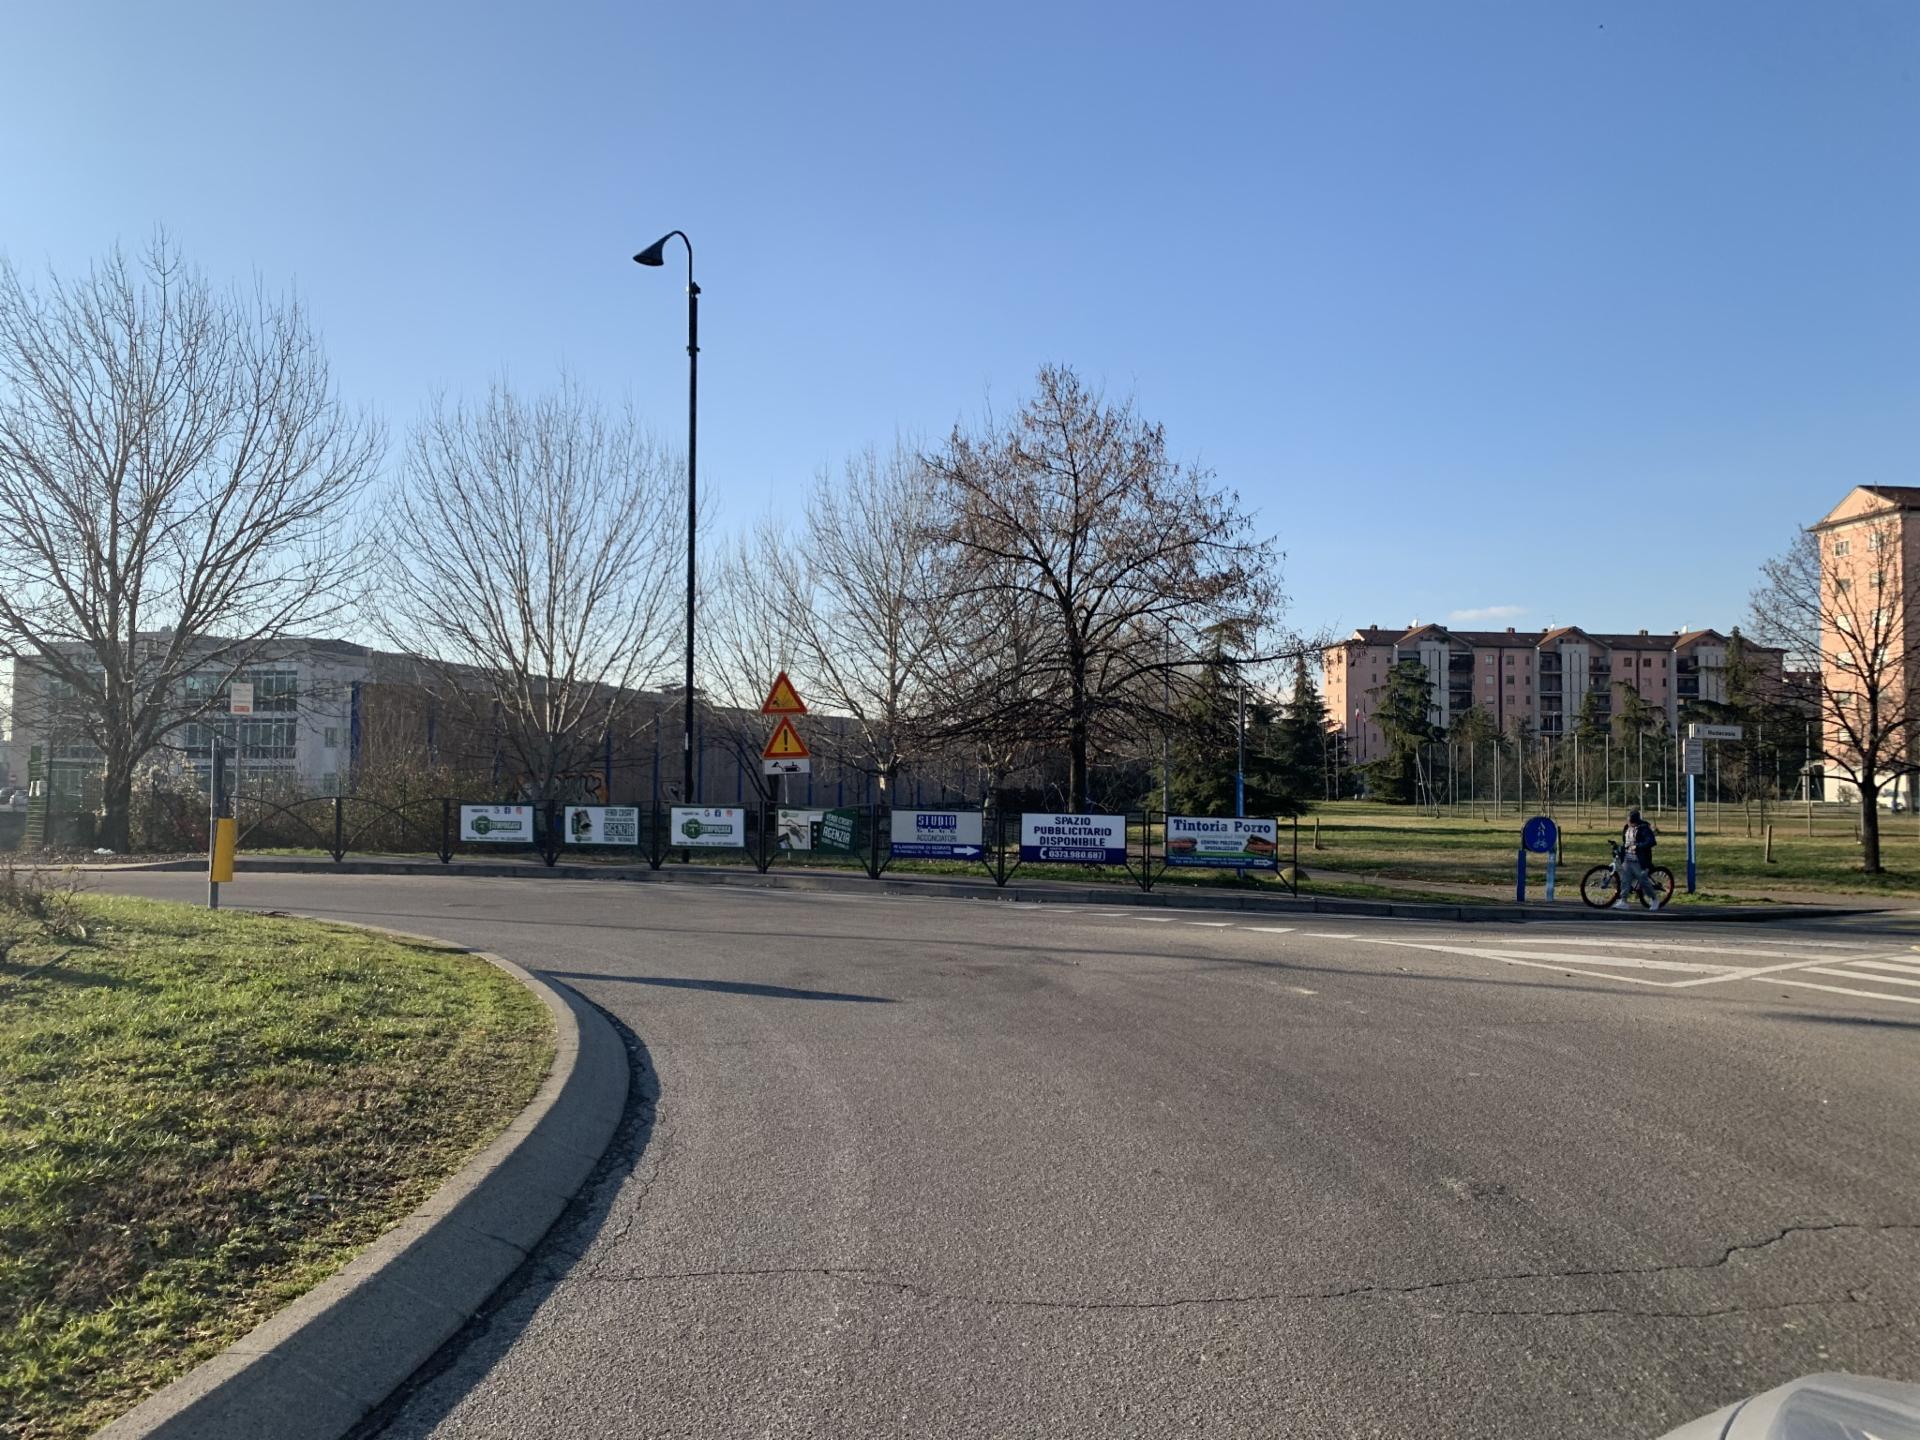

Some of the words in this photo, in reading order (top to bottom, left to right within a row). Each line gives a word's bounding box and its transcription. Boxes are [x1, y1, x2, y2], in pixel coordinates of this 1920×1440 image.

[917, 815, 956, 827] STUDIO
[1055, 816, 1091, 826] SPAZIO
[1173, 819, 1228, 832] Tintoria
[1234, 821, 1271, 833] Porro
[822, 826, 851, 844] AGENZIA
[1033, 826, 1112, 836] PUBBLICITARIO
[1039, 836, 1106, 847] DISPONIBILE
